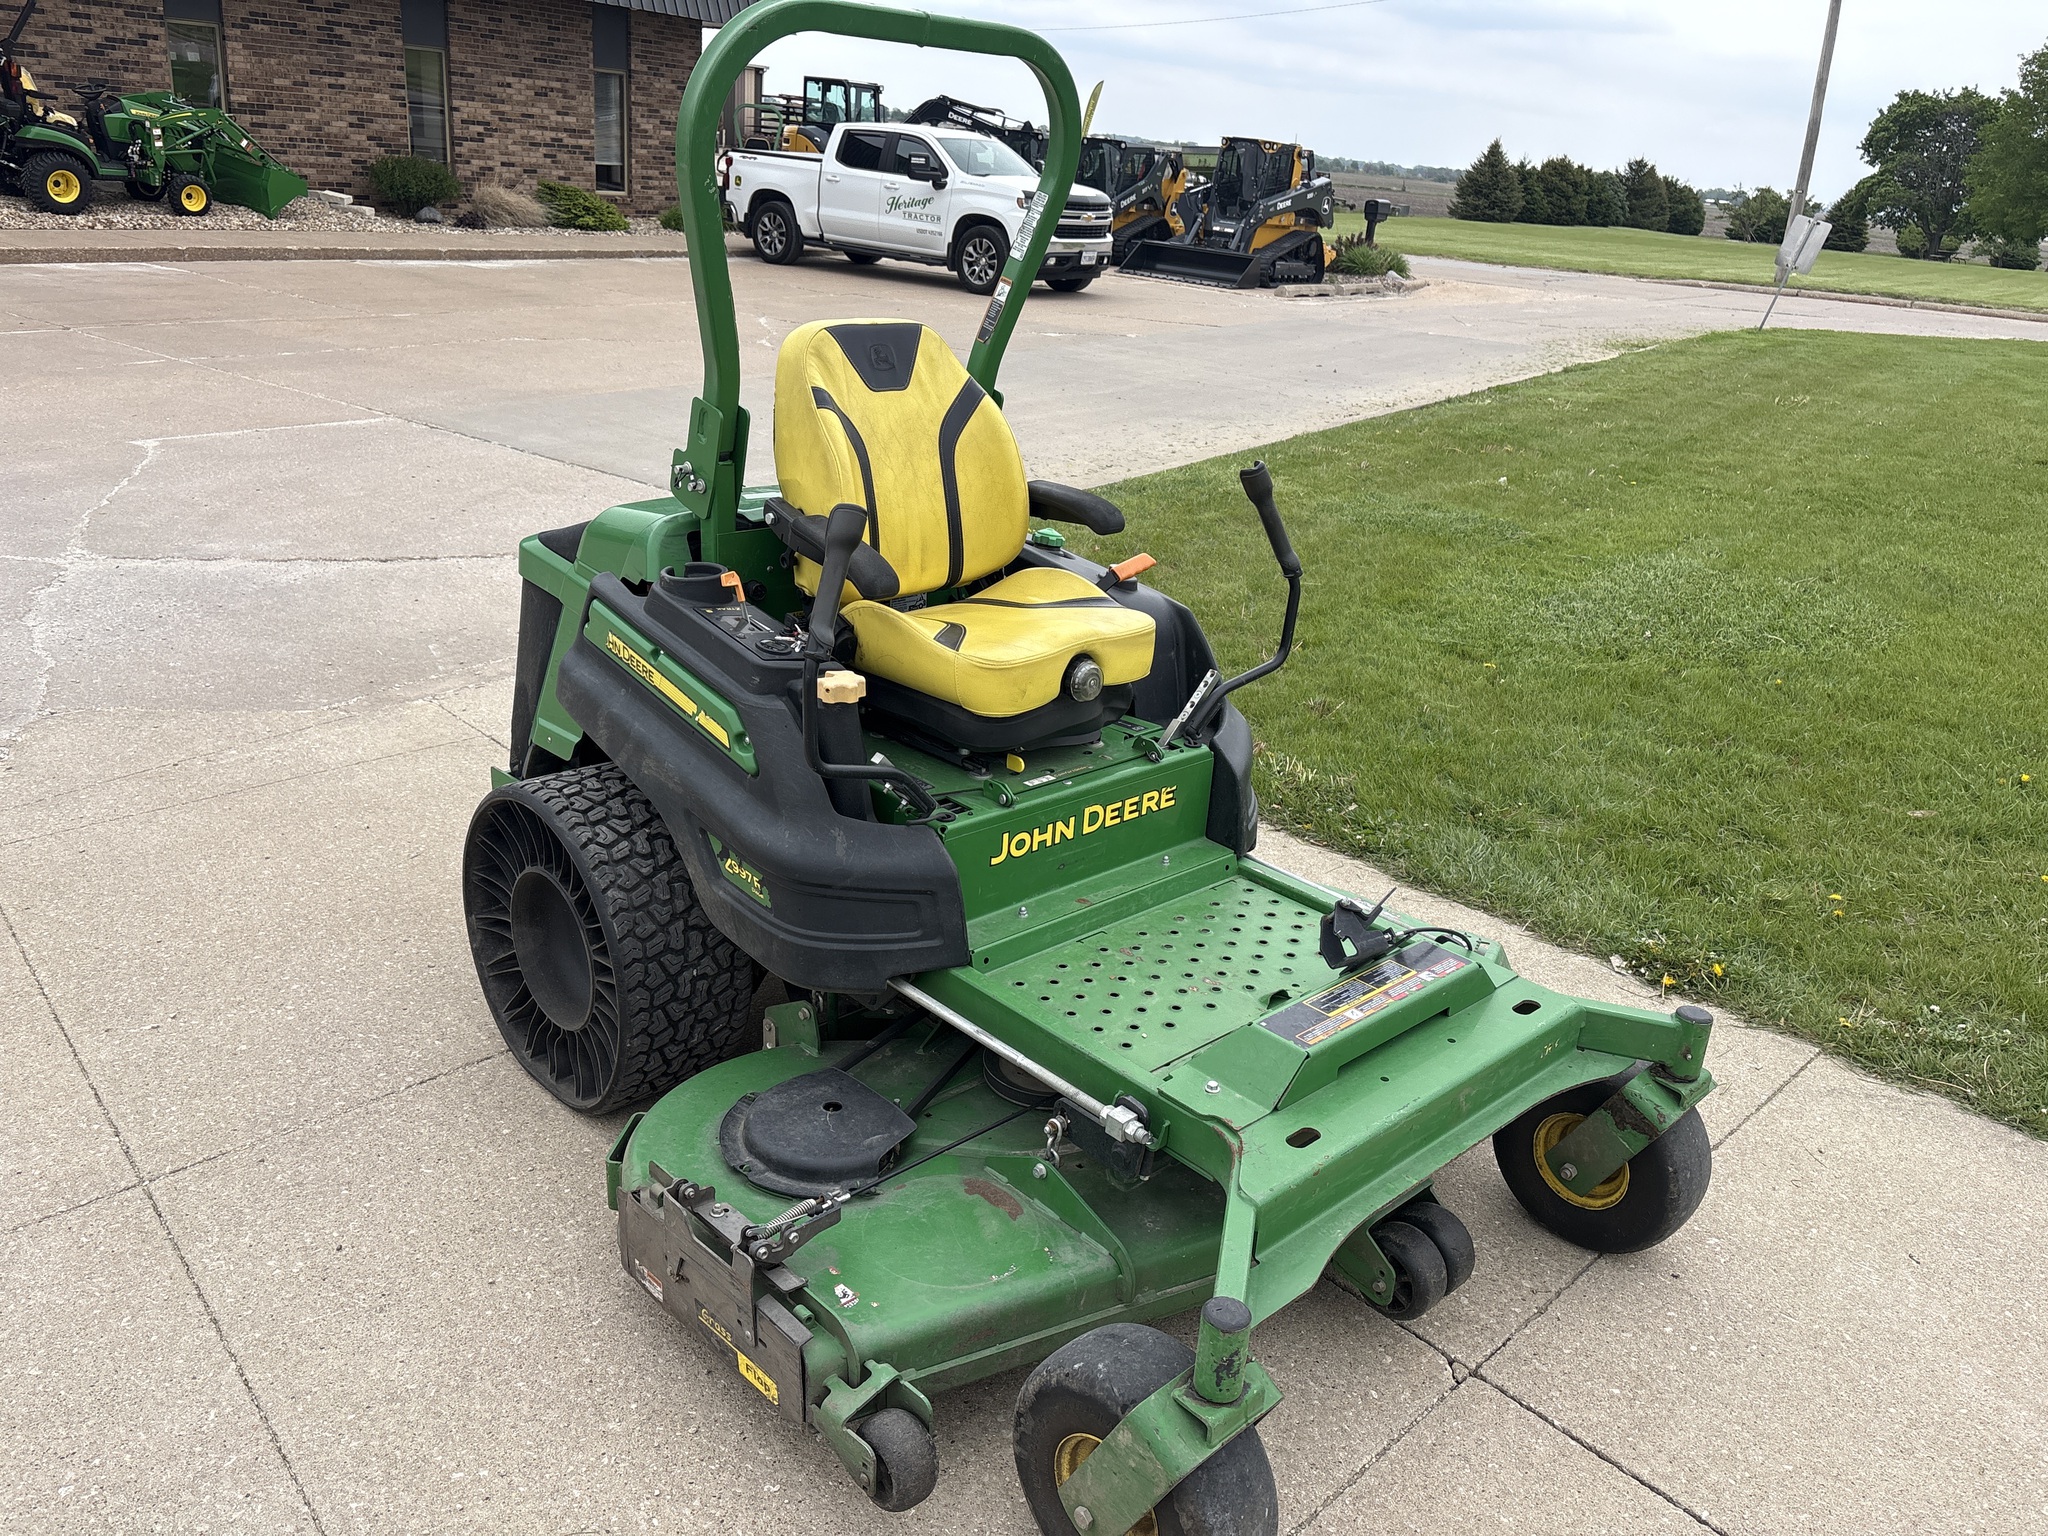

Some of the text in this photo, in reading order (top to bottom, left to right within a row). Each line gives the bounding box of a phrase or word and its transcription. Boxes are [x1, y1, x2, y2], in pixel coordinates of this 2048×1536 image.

[948, 111, 973, 126] DEERE
[885, 195, 935, 215] Heritage
[902, 212, 942, 223] TRACTOR
[622, 644, 655, 684] DEERE
[989, 785, 1178, 867] JOHN DEERE
[701, 1308, 772, 1394] Grass Flap
